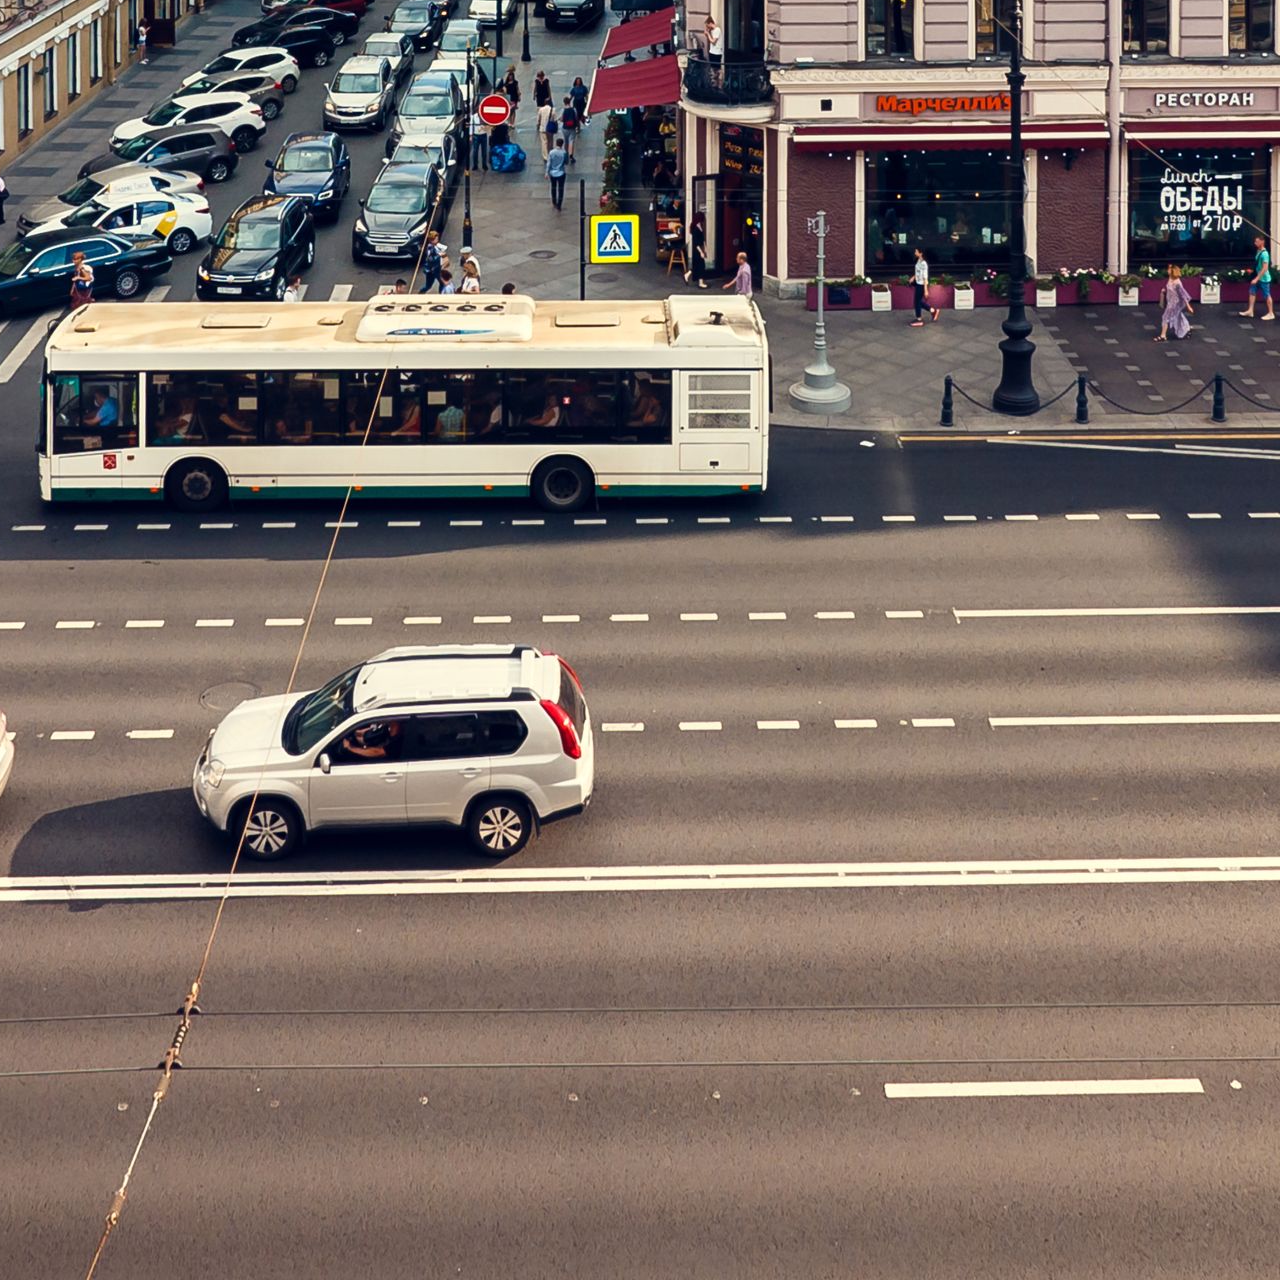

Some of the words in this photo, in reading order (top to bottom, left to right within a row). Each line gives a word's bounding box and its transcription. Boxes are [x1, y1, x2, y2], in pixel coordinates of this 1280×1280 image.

[1155, 92, 1254, 107] РЕСТОРАН
[1160, 167, 1213, 184] Lunch
[1160, 186, 1243, 215] ОБЕДЫ
